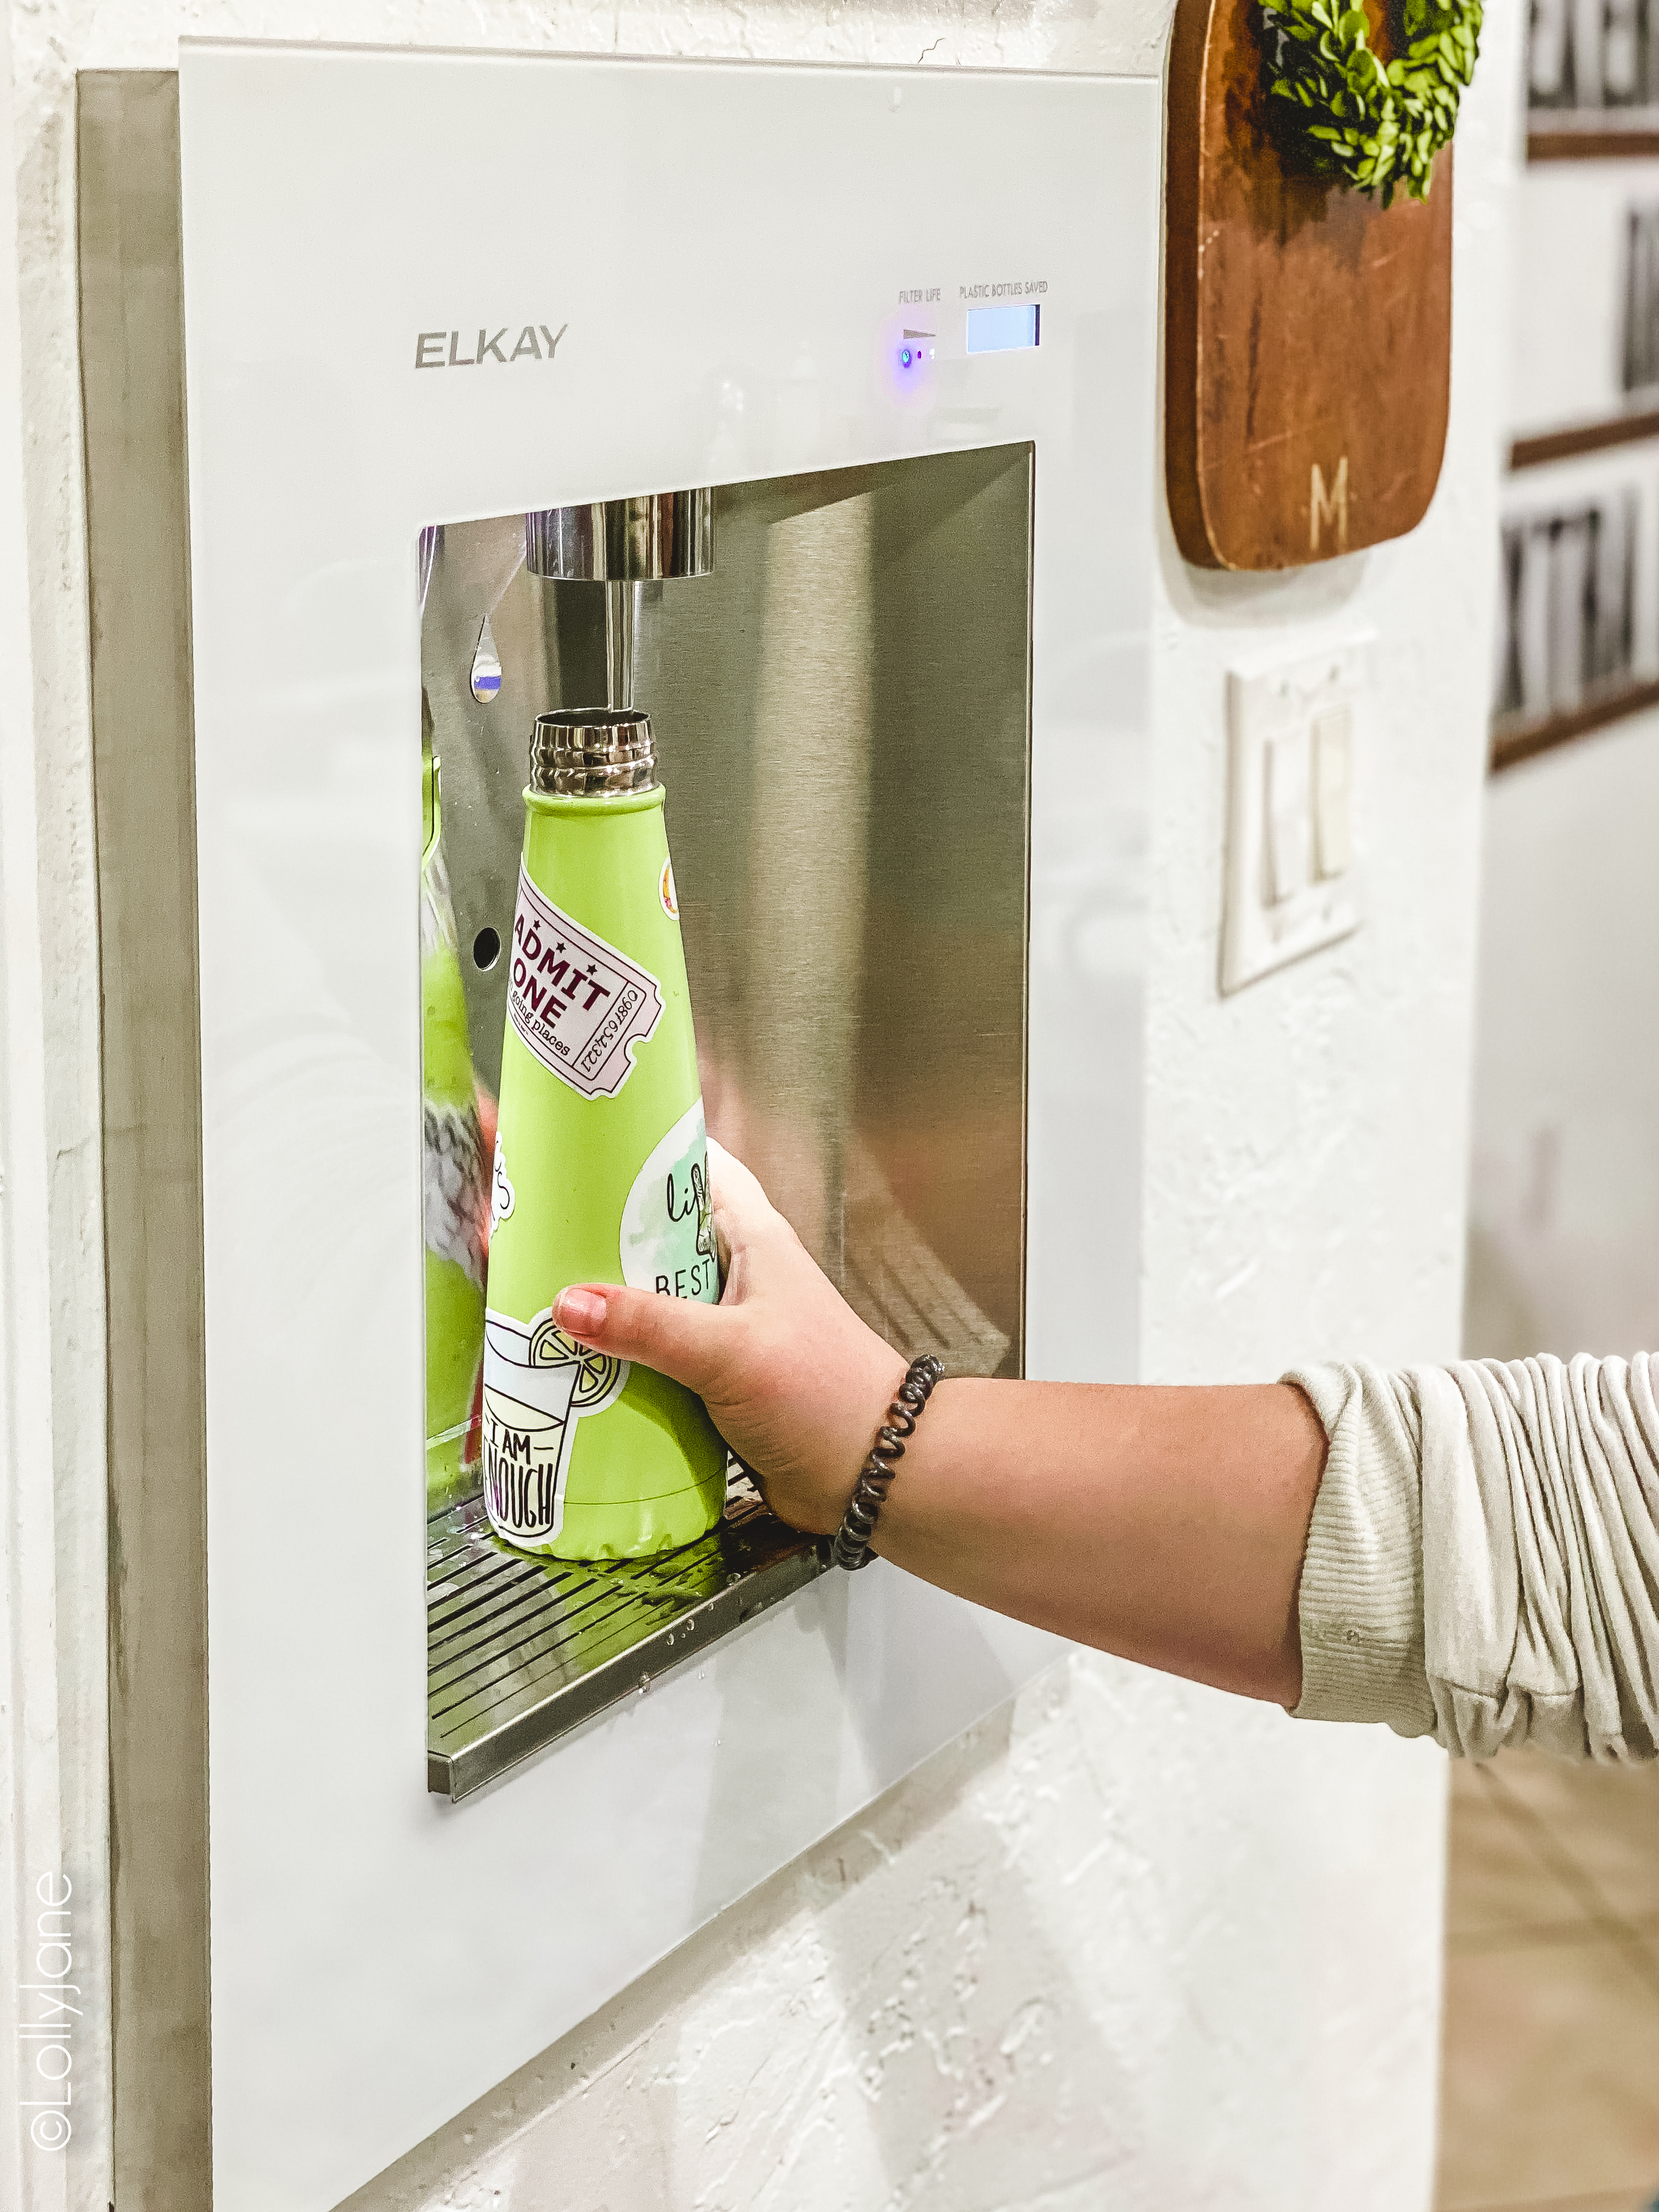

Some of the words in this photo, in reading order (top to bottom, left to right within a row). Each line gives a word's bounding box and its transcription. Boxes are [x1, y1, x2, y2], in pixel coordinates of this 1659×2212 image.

[899, 289, 923, 304] FILTER
[926, 287, 941, 302] LIFE
[960, 284, 990, 298] PLASTIC
[992, 283, 1022, 297] BOTTLES
[1025, 280, 1048, 294] SAVED
[415, 323, 569, 369] ELKAY
[1310, 455, 1348, 550] M
[513, 957, 568, 1029] ONE
[514, 913, 611, 1012] ADMIT
[512, 990, 534, 1024] going
[531, 1019, 571, 1057] places
[580, 990, 638, 1073] 0987654321
[490, 1418, 499, 1448] I
[502, 1429, 531, 1465] AM
